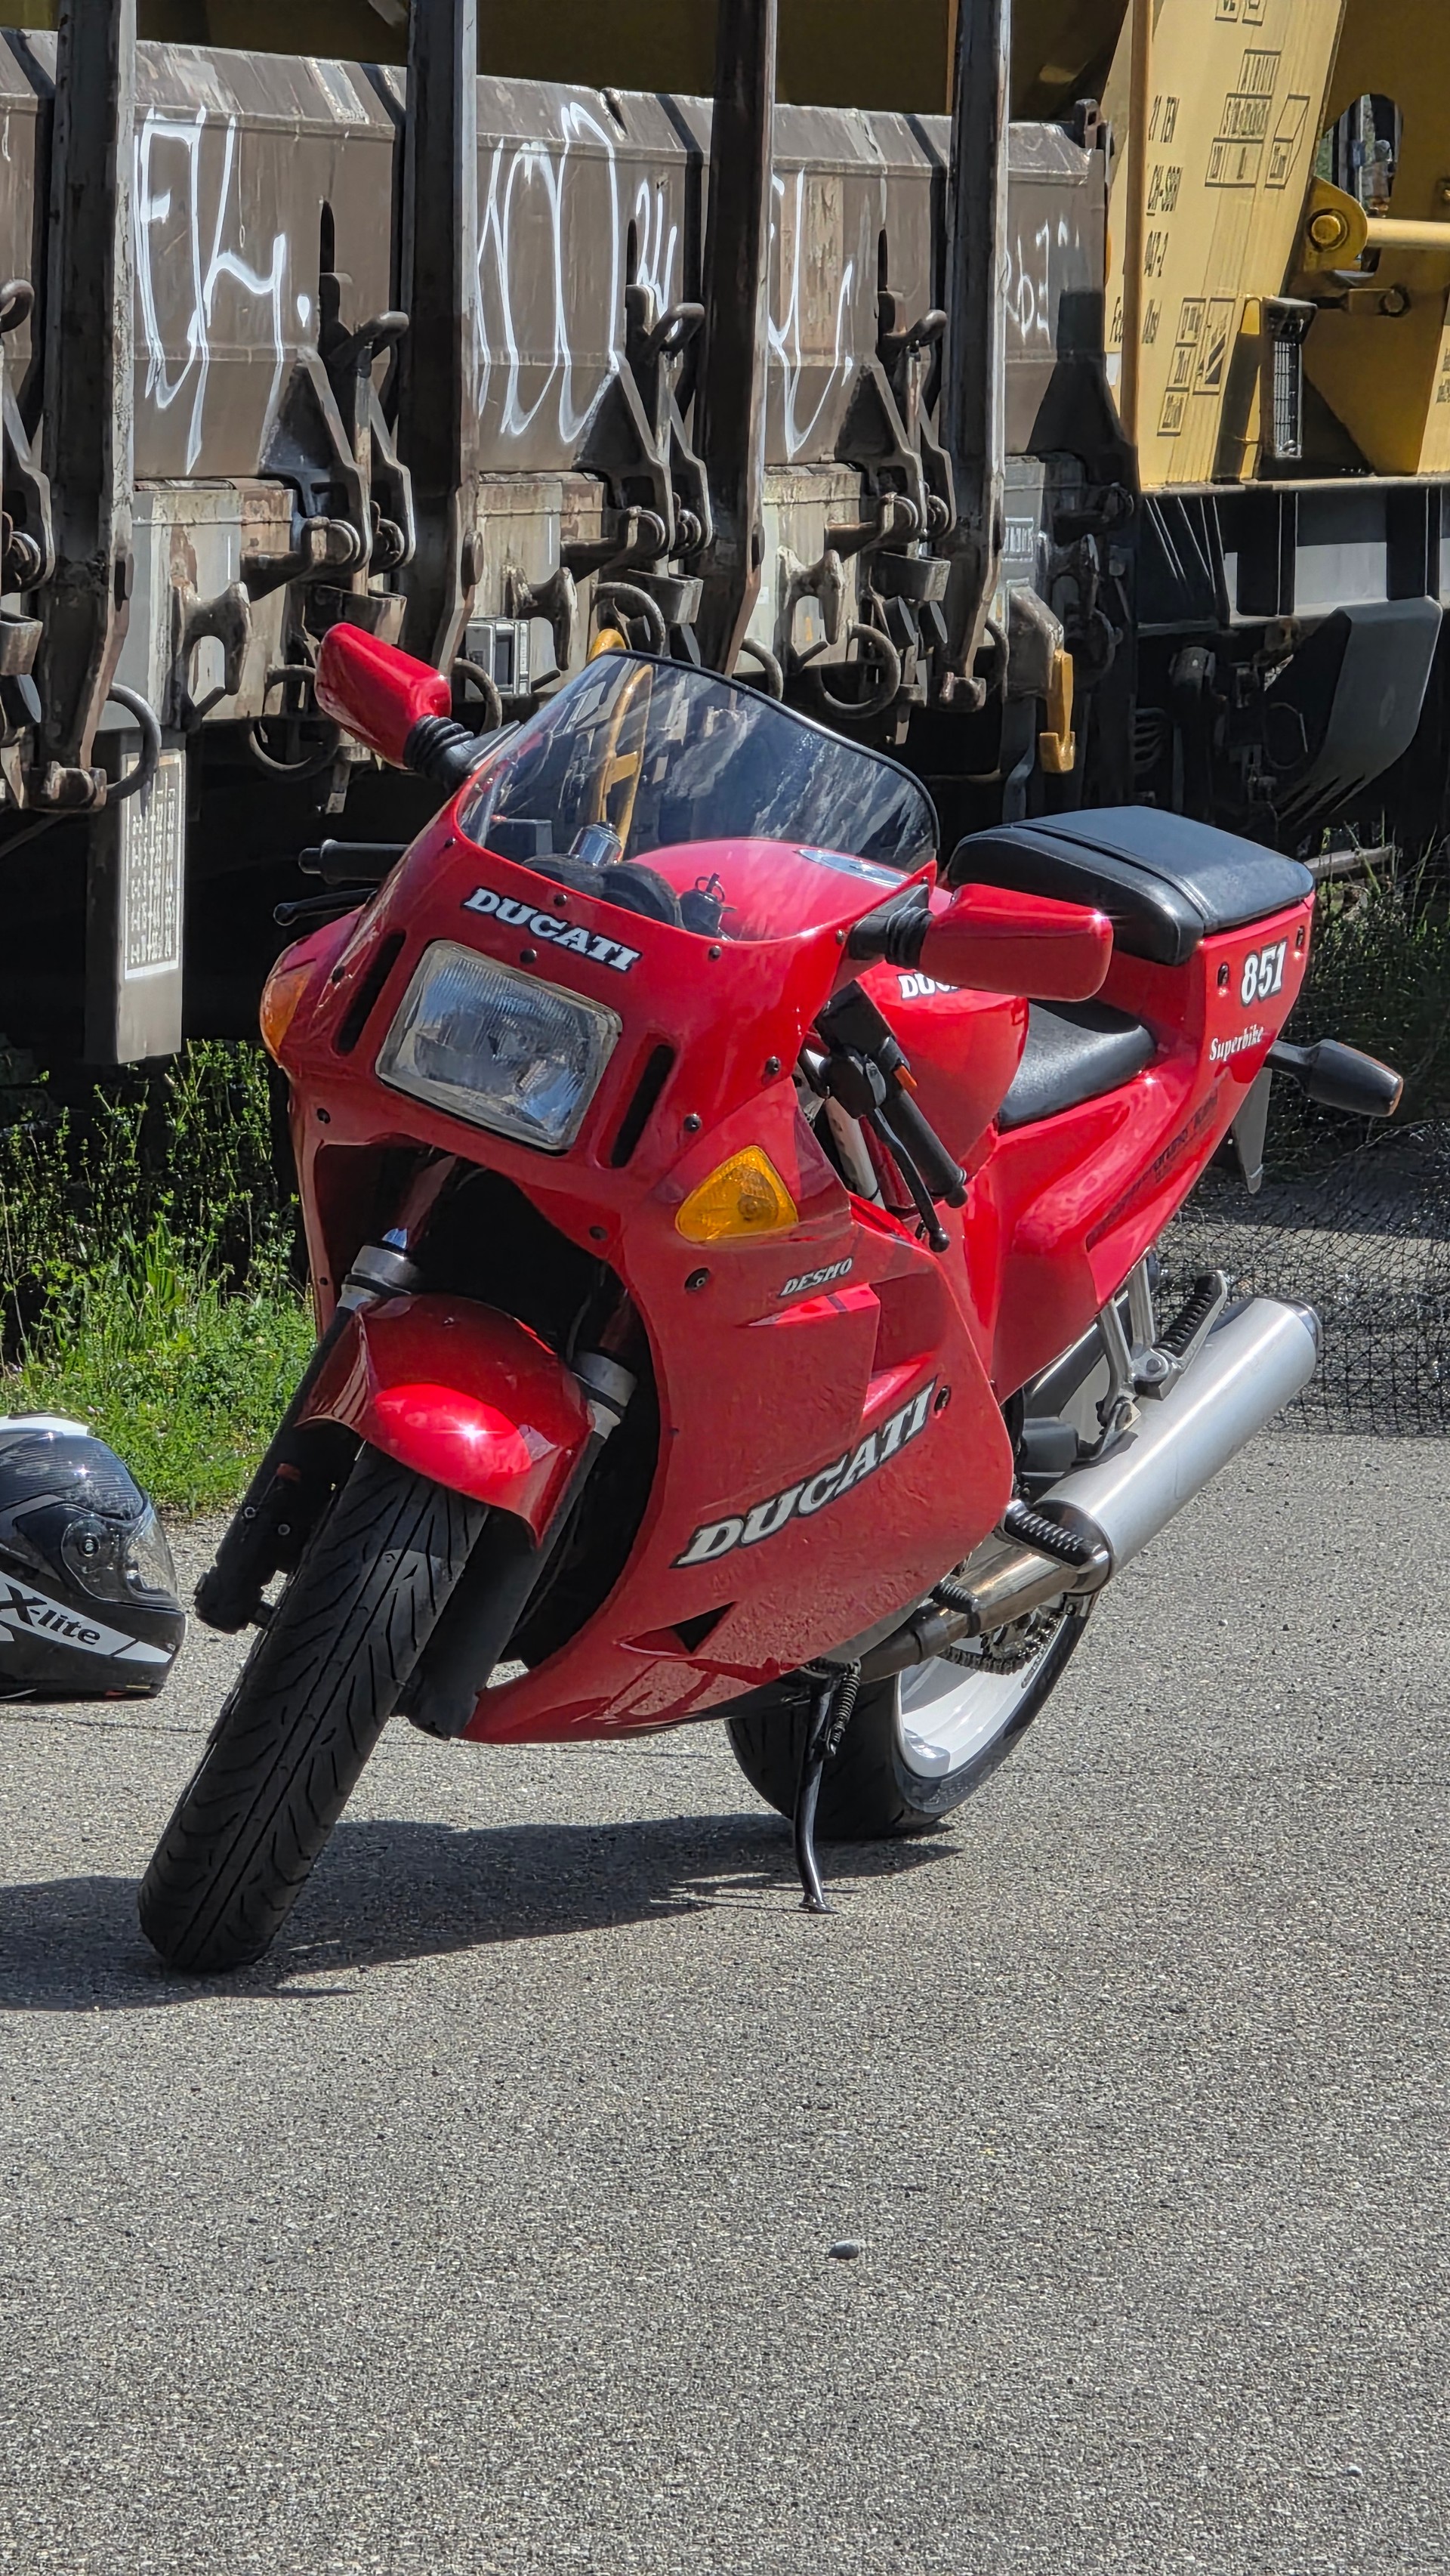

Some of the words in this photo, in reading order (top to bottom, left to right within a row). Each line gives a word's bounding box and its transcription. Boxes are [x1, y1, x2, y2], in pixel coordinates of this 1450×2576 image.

[463, 887, 642, 972] DUCATI
[1241, 939, 1288, 1005] 851
[1209, 1024, 1264, 1061] Superbike
[779, 1256, 853, 1297] DESMO
[672, 1379, 937, 1567] DUCATI
[0, 1582, 100, 1645] X-lite
